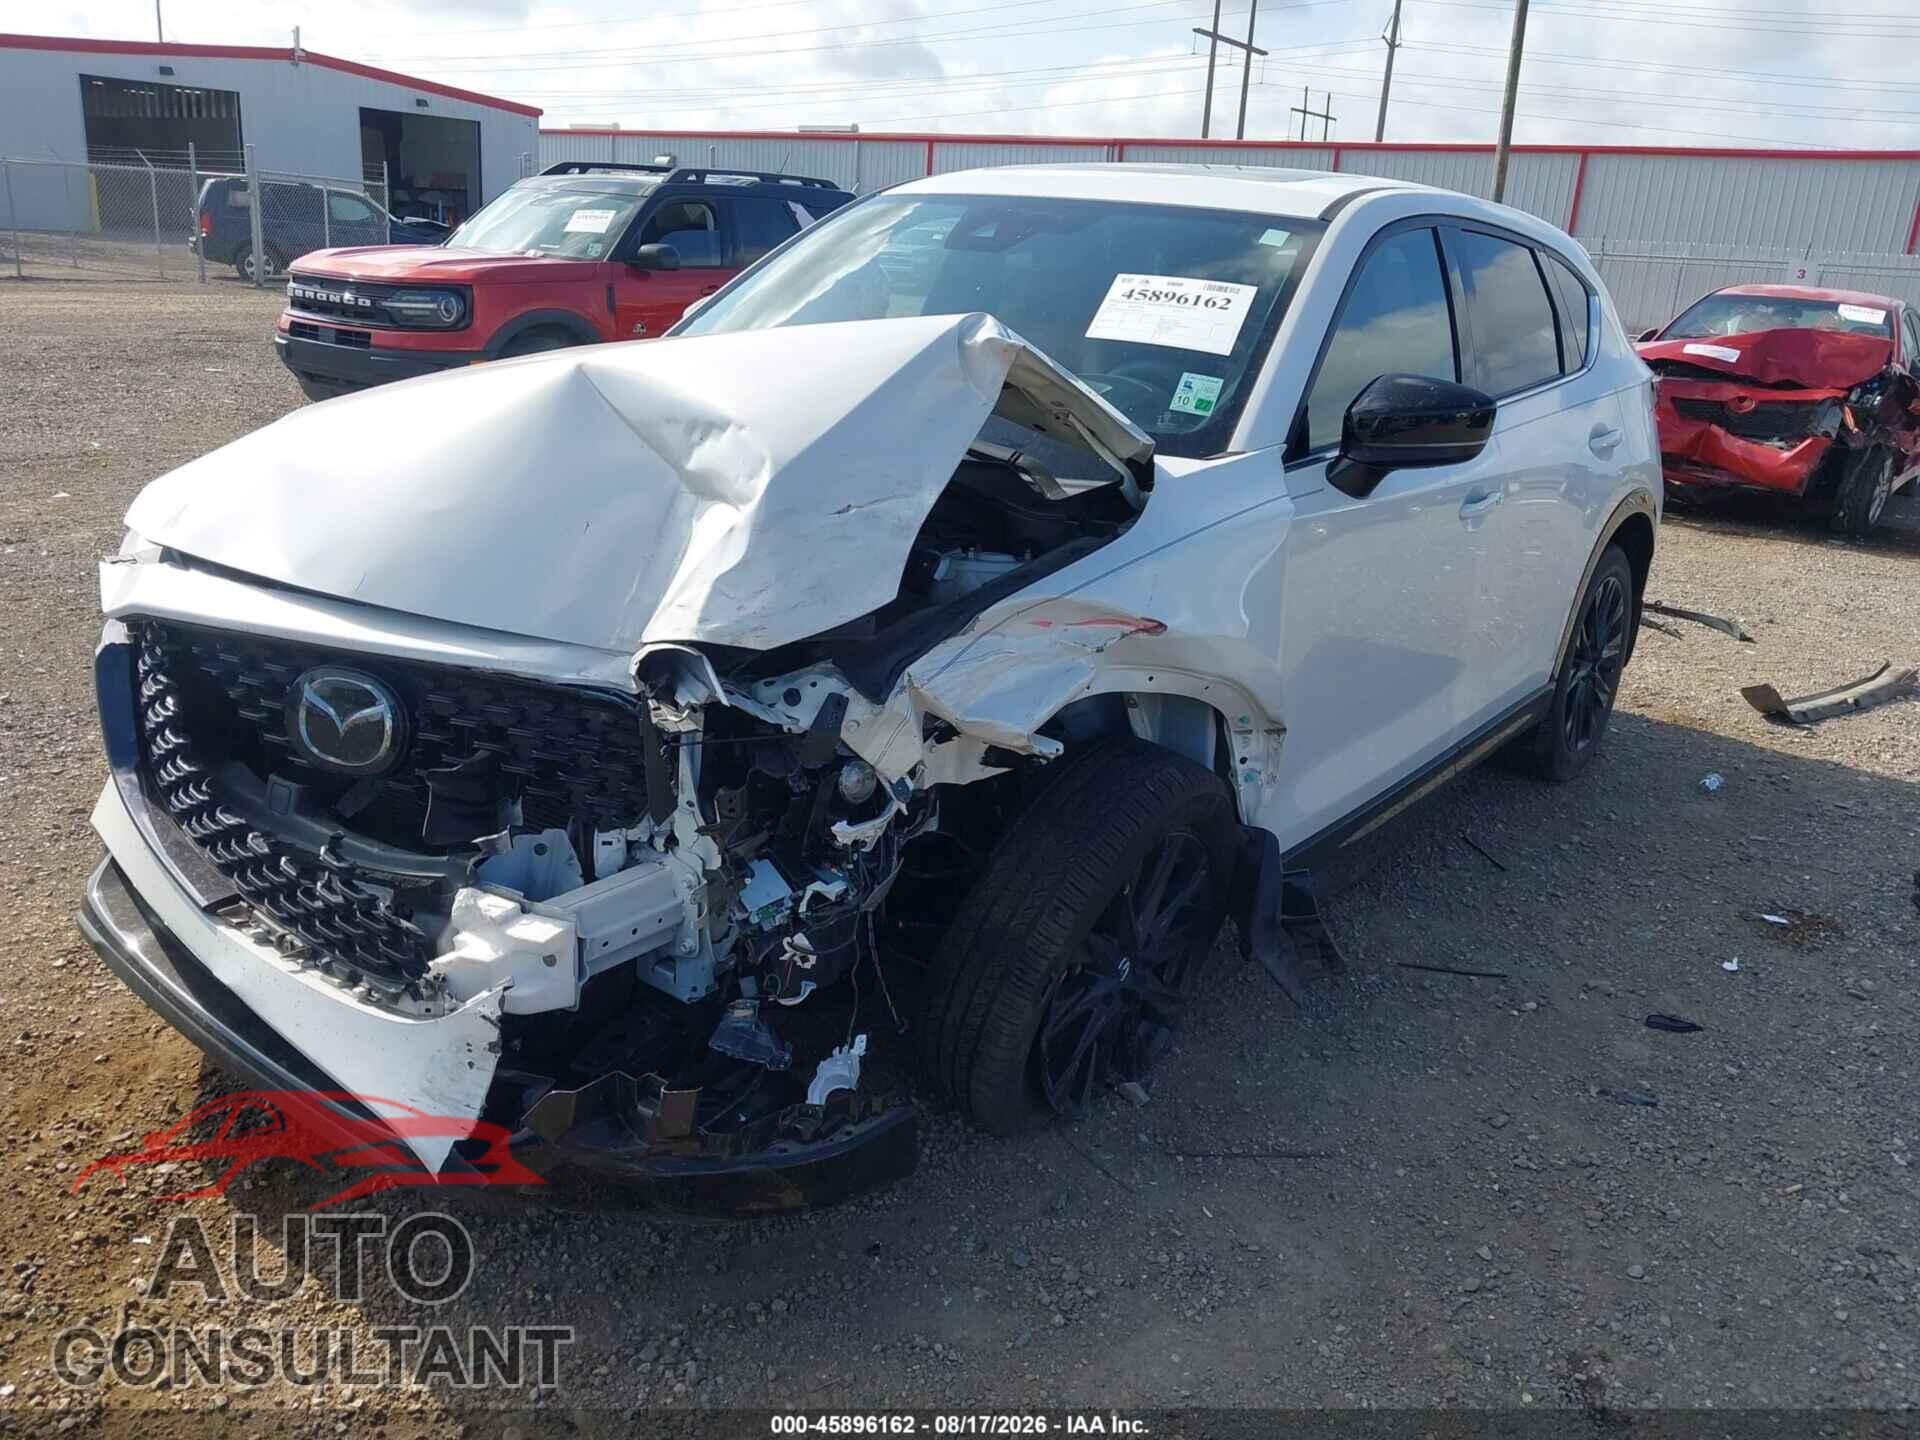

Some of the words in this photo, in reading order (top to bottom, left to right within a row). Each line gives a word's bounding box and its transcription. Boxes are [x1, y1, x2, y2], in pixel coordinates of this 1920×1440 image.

[1796, 268, 1806, 279] 3
[294, 288, 371, 307] BRONCO
[1121, 288, 1232, 311] 45896162
[1176, 395, 1190, 405] 10
